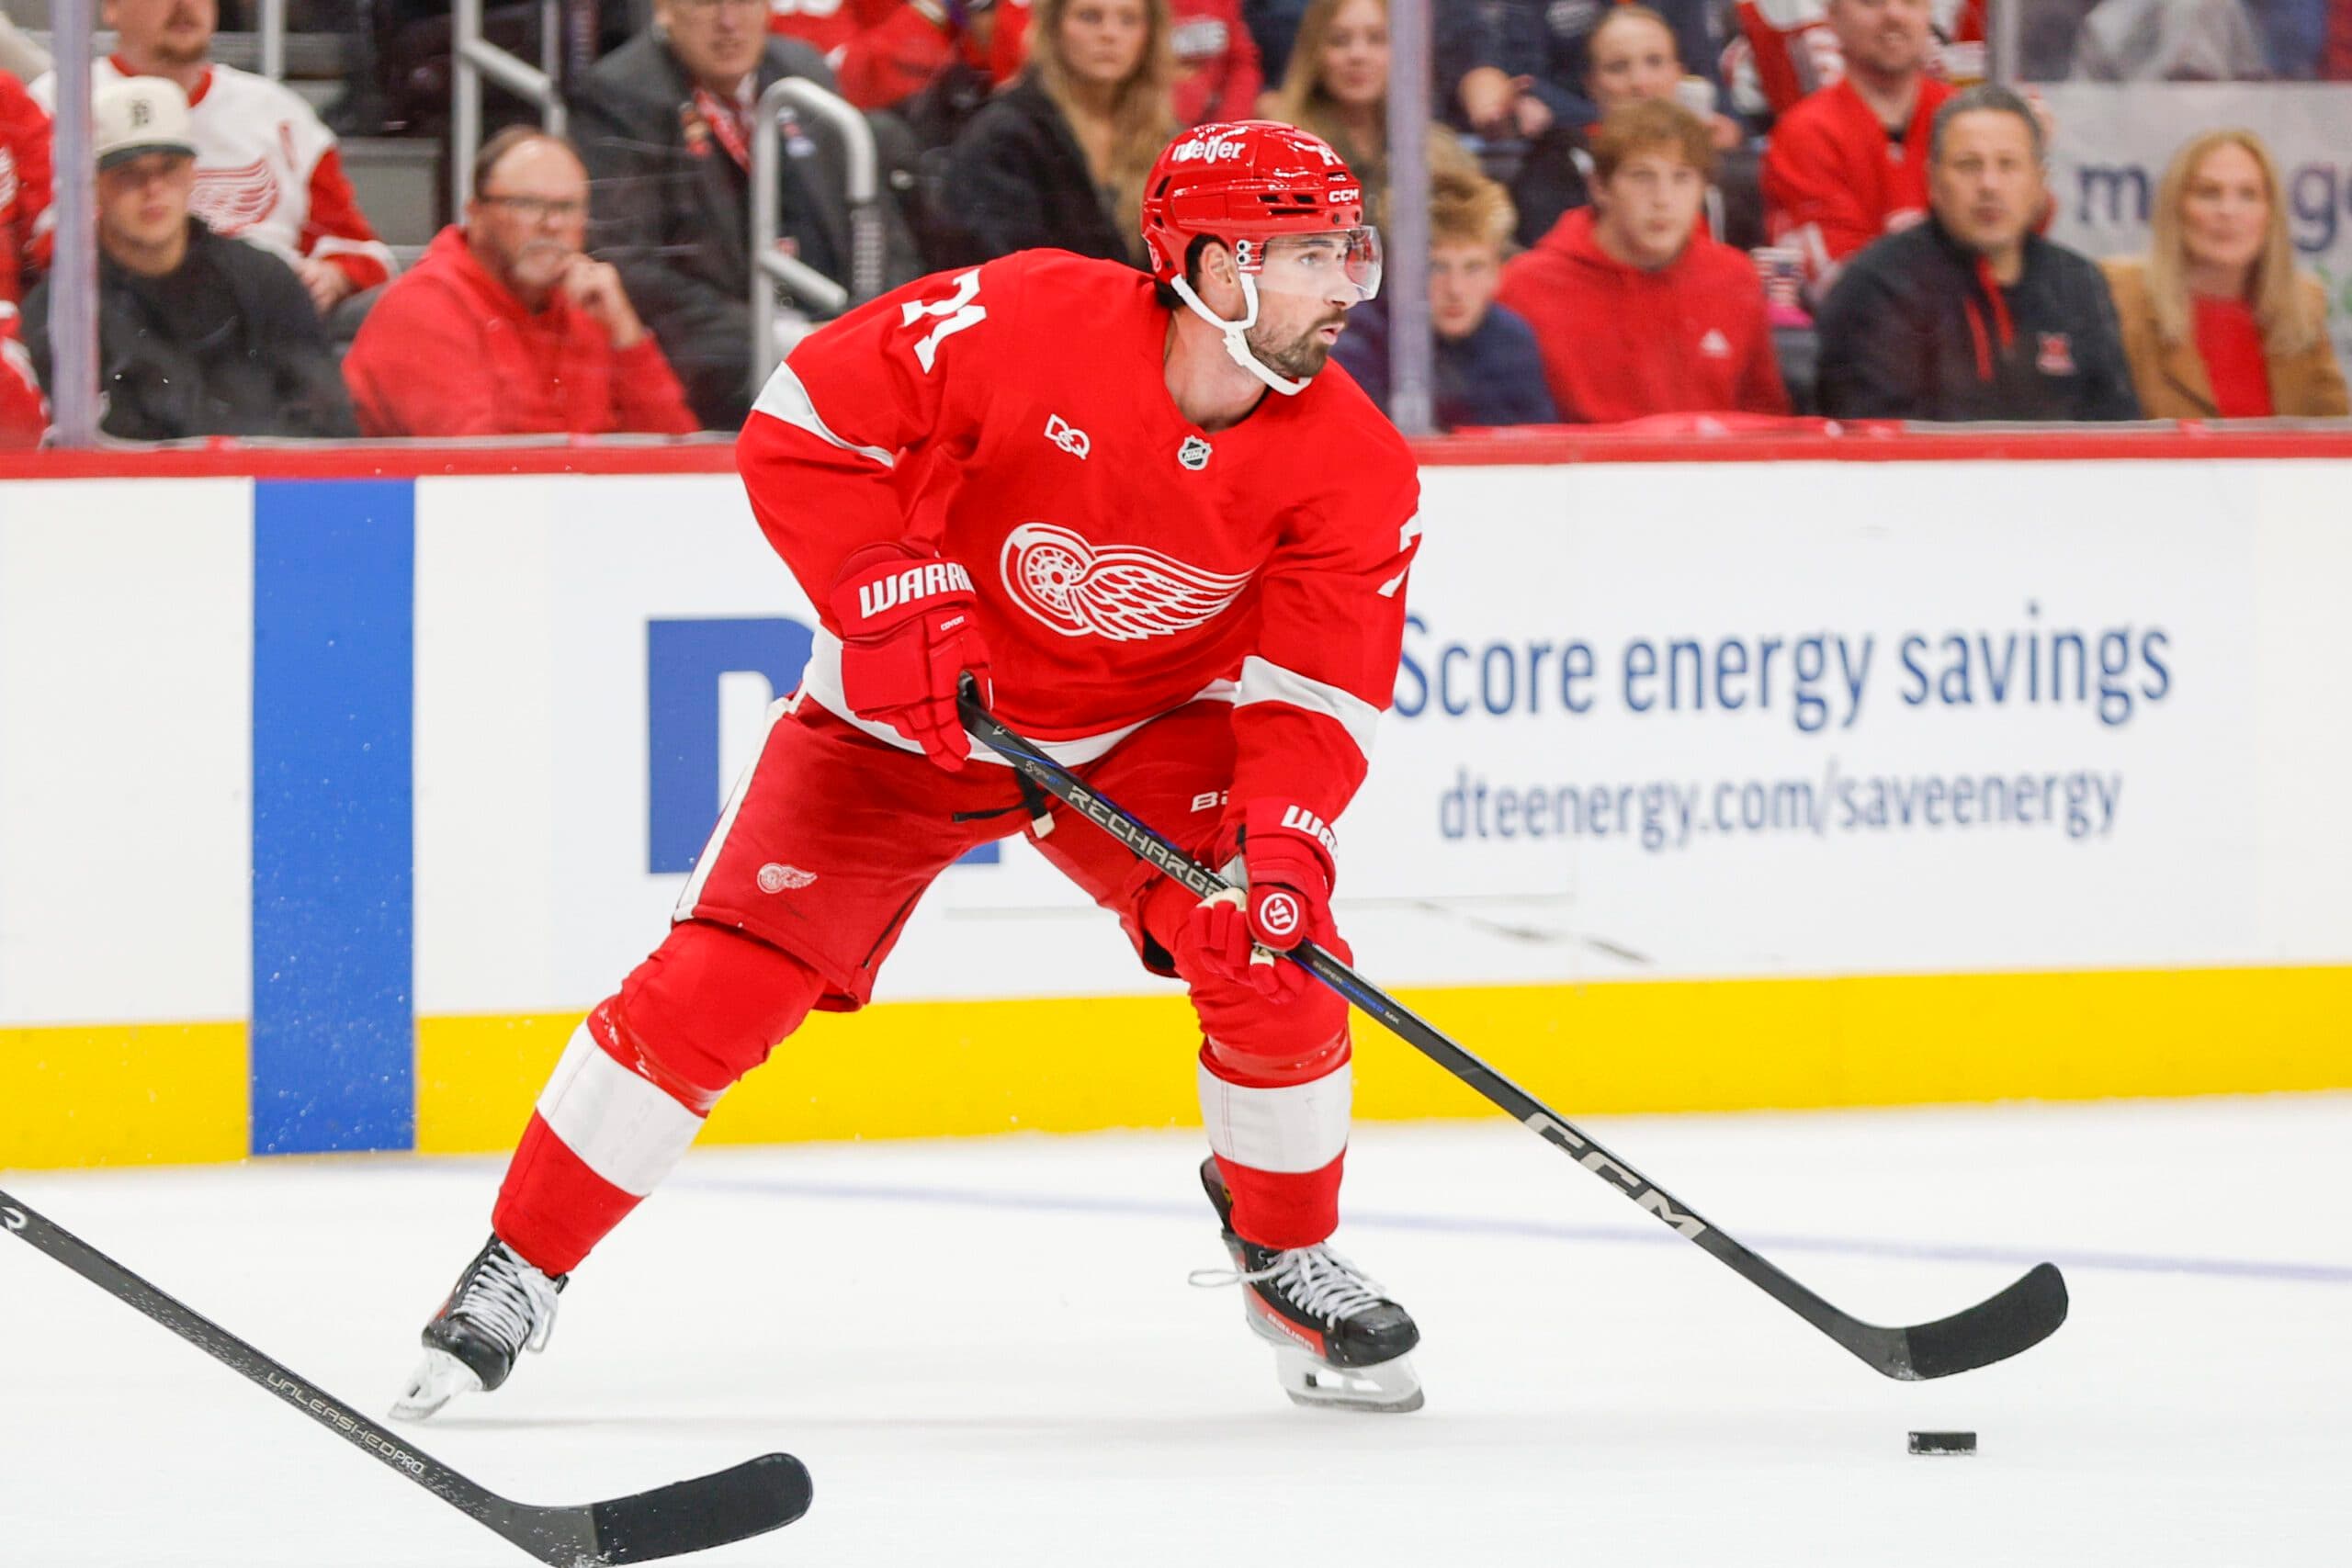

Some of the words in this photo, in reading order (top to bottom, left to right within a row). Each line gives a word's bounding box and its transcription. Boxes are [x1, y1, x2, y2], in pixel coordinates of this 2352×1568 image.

[1329, 187, 1360, 203] CCM
[1393, 614, 1596, 719] Score
[1623, 633, 1875, 734] energy
[1898, 603, 2172, 728] savings
[1440, 761, 2121, 852] dteenergy.com/saveenergy
[1522, 1111, 1708, 1241] CCM
